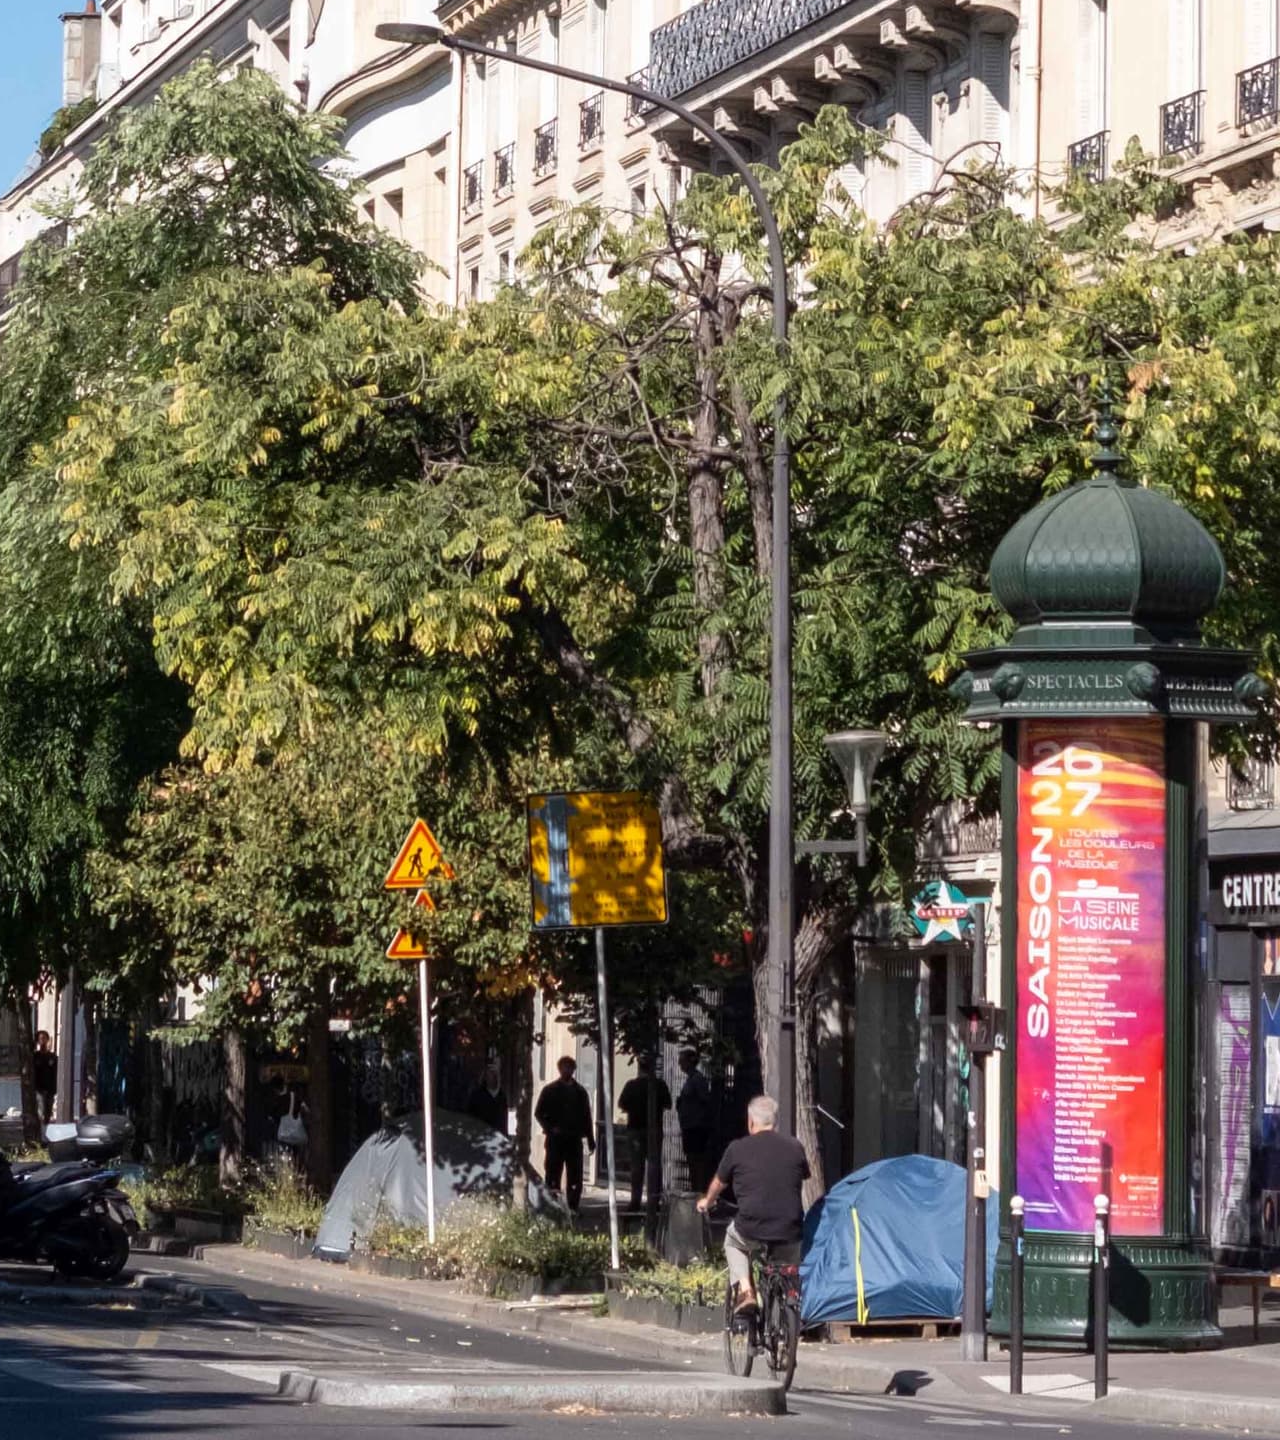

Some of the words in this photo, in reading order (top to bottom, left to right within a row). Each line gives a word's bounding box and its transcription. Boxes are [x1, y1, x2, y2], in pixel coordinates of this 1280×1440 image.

[1026, 674, 1124, 690] SPECTACLES
[1031, 740, 1104, 777] 26
[1030, 780, 1102, 817] 27
[1068, 828, 1120, 838] TOUTES
[1059, 837, 1082, 848] LES
[1083, 838, 1156, 850] COULEURS
[1067, 849, 1084, 859] DE
[1086, 850, 1104, 859] LA
[1057, 859, 1119, 870] MUSIQUE
[1057, 899, 1082, 913] LA
[1086, 900, 1140, 916] SEINE
[1057, 915, 1140, 932] MUSICALE
[1028, 826, 1055, 1039] SAISON
